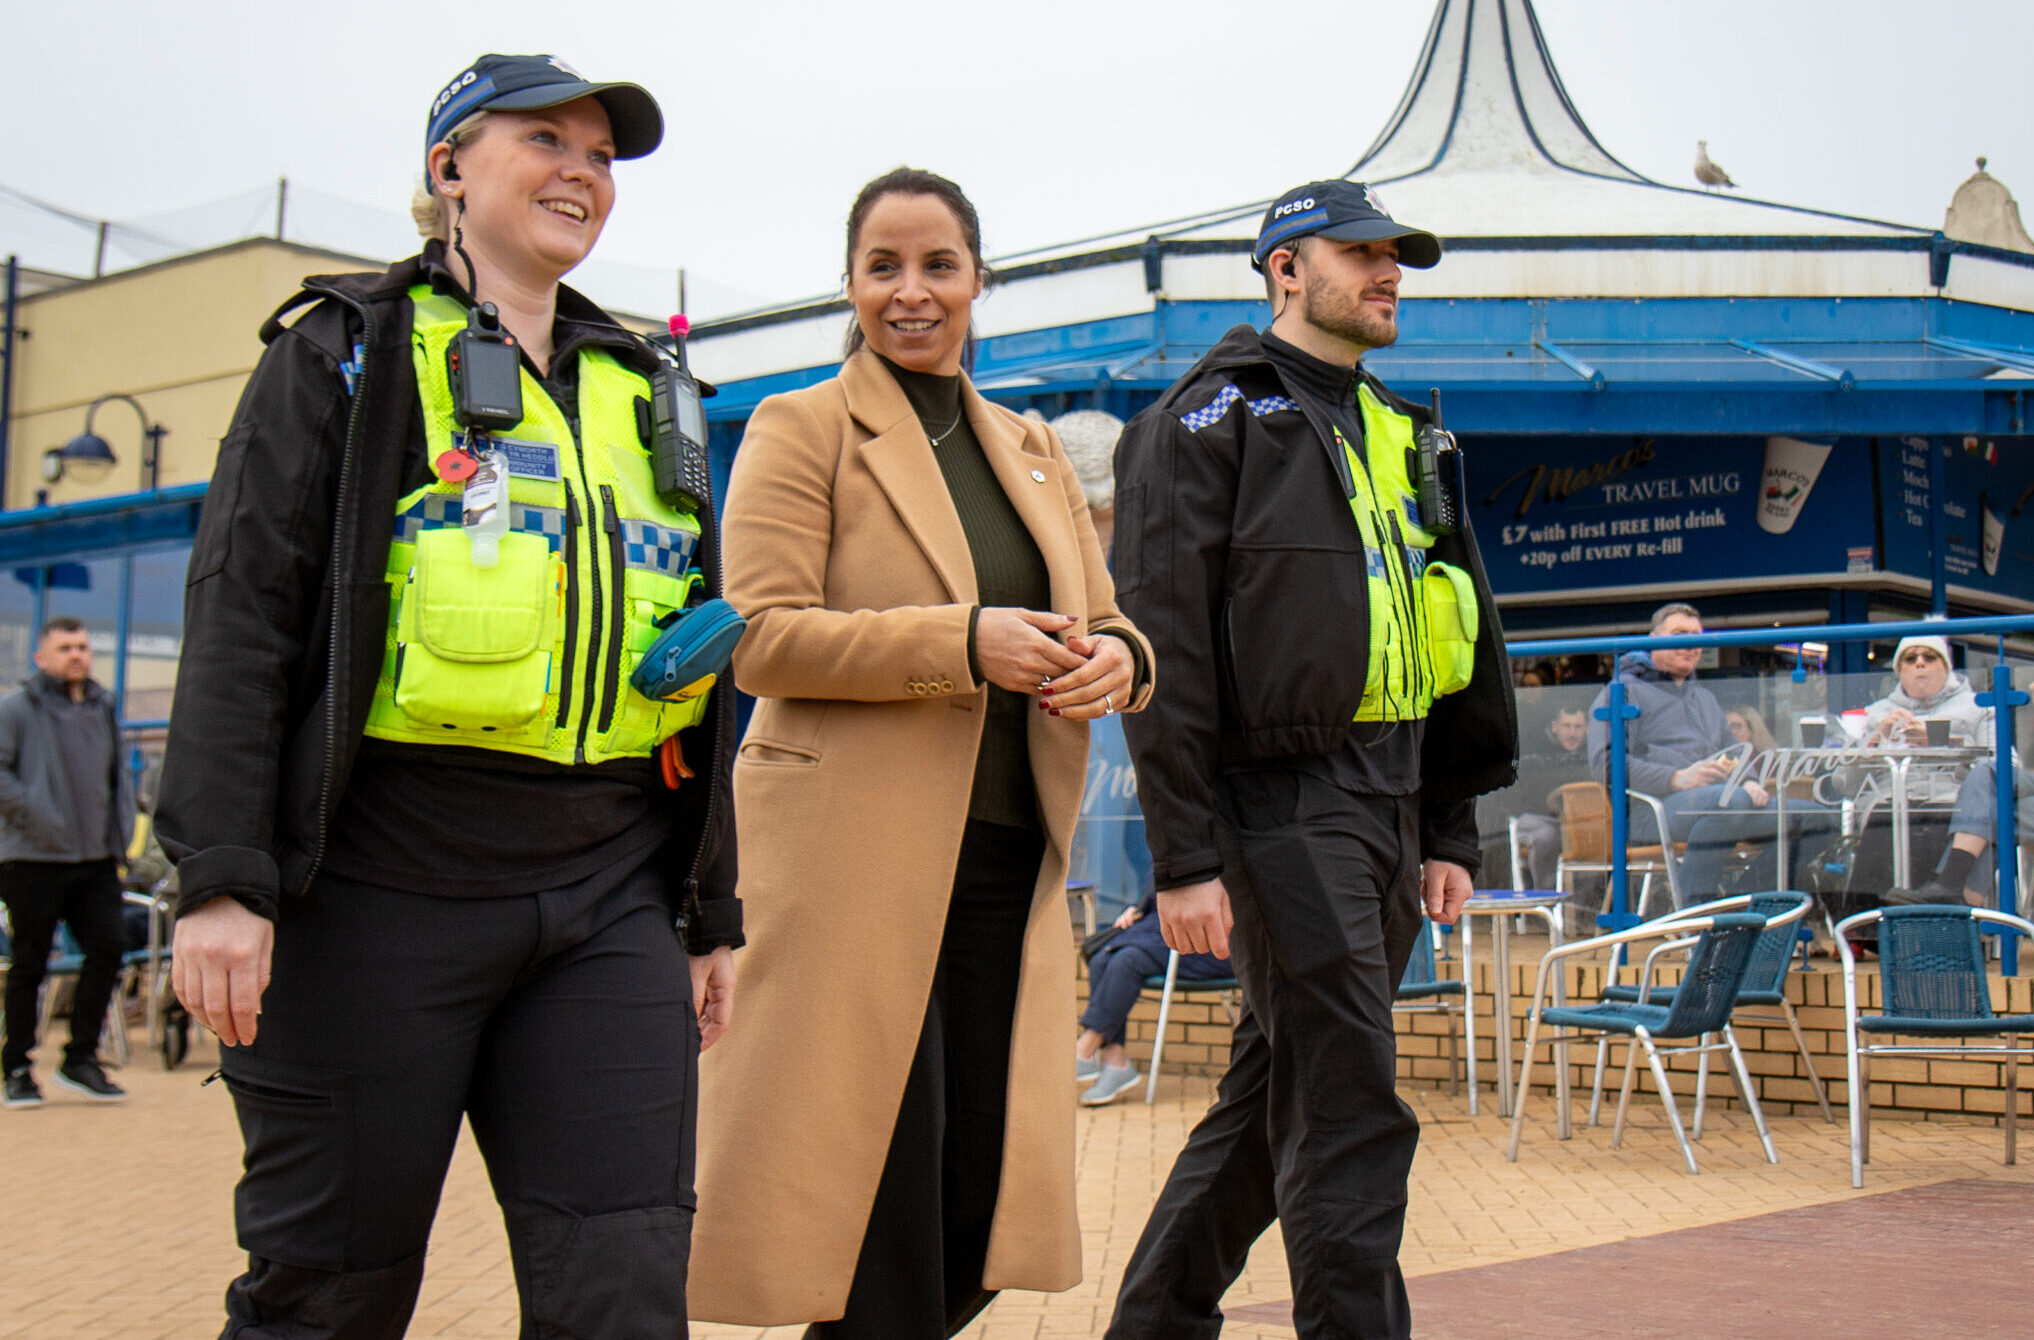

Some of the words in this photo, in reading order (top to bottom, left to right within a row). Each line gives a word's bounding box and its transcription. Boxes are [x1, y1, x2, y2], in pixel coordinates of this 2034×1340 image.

[433, 70, 477, 116] PCSO
[1274, 197, 1316, 220] PCSO
[1902, 448, 1926, 469] Latte
[1601, 480, 1685, 505] TRAVEL
[1689, 472, 1741, 498] MUG
[1903, 469, 1930, 489] Moch
[1904, 489, 1921, 507] Hot
[1502, 524, 1529, 546] £7
[1529, 523, 1566, 543] with
[1570, 521, 1606, 539] First
[1611, 518, 1650, 536] FREE
[1654, 514, 1682, 532] Hot
[1684, 507, 1727, 530] drink
[1906, 509, 1923, 527] Tea
[1520, 549, 1558, 570] +20p
[1561, 545, 1583, 564] off
[1585, 542, 1633, 562] EVERY
[1636, 536, 1684, 558] Re-fill
